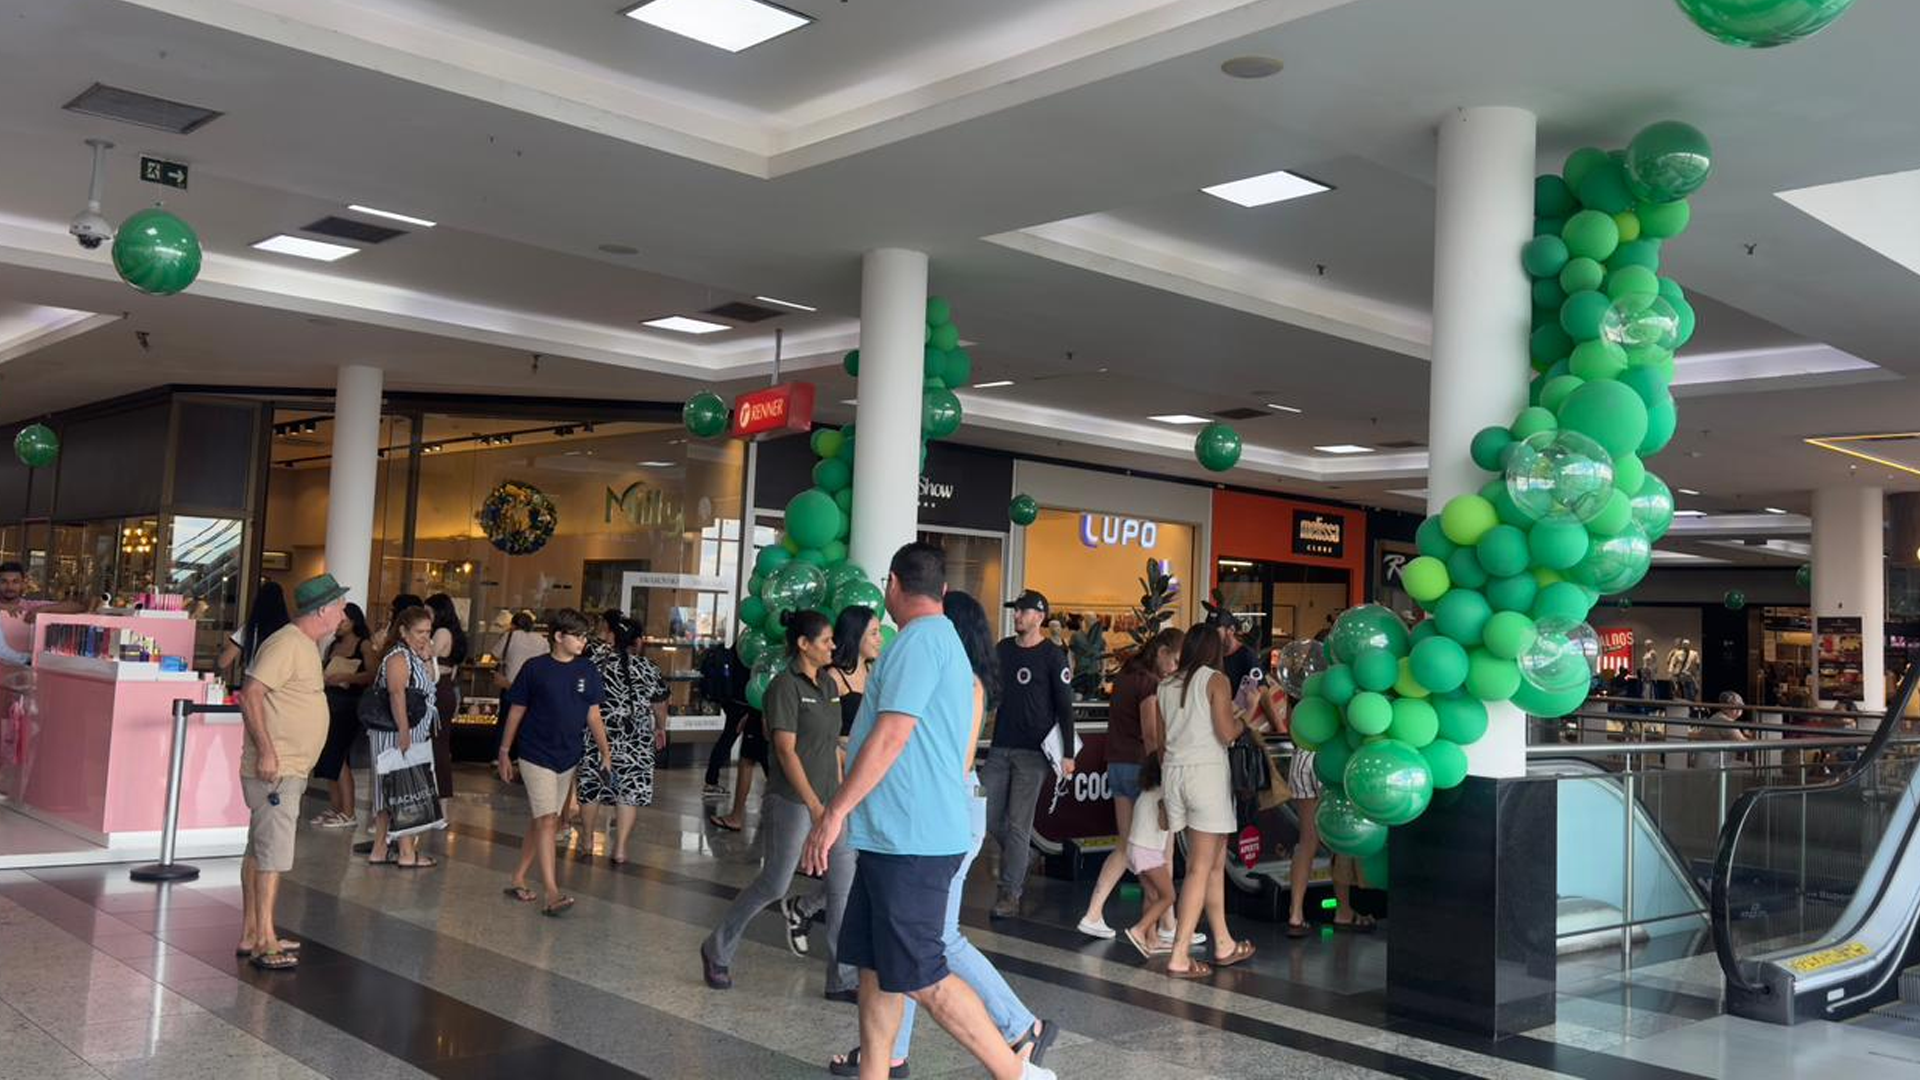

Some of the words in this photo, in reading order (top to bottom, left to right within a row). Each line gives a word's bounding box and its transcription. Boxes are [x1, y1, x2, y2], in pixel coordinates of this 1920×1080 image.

[751, 398, 784, 420] RENNER
[1082, 514, 1157, 549] LUPO
[1299, 516, 1341, 543] melissa
